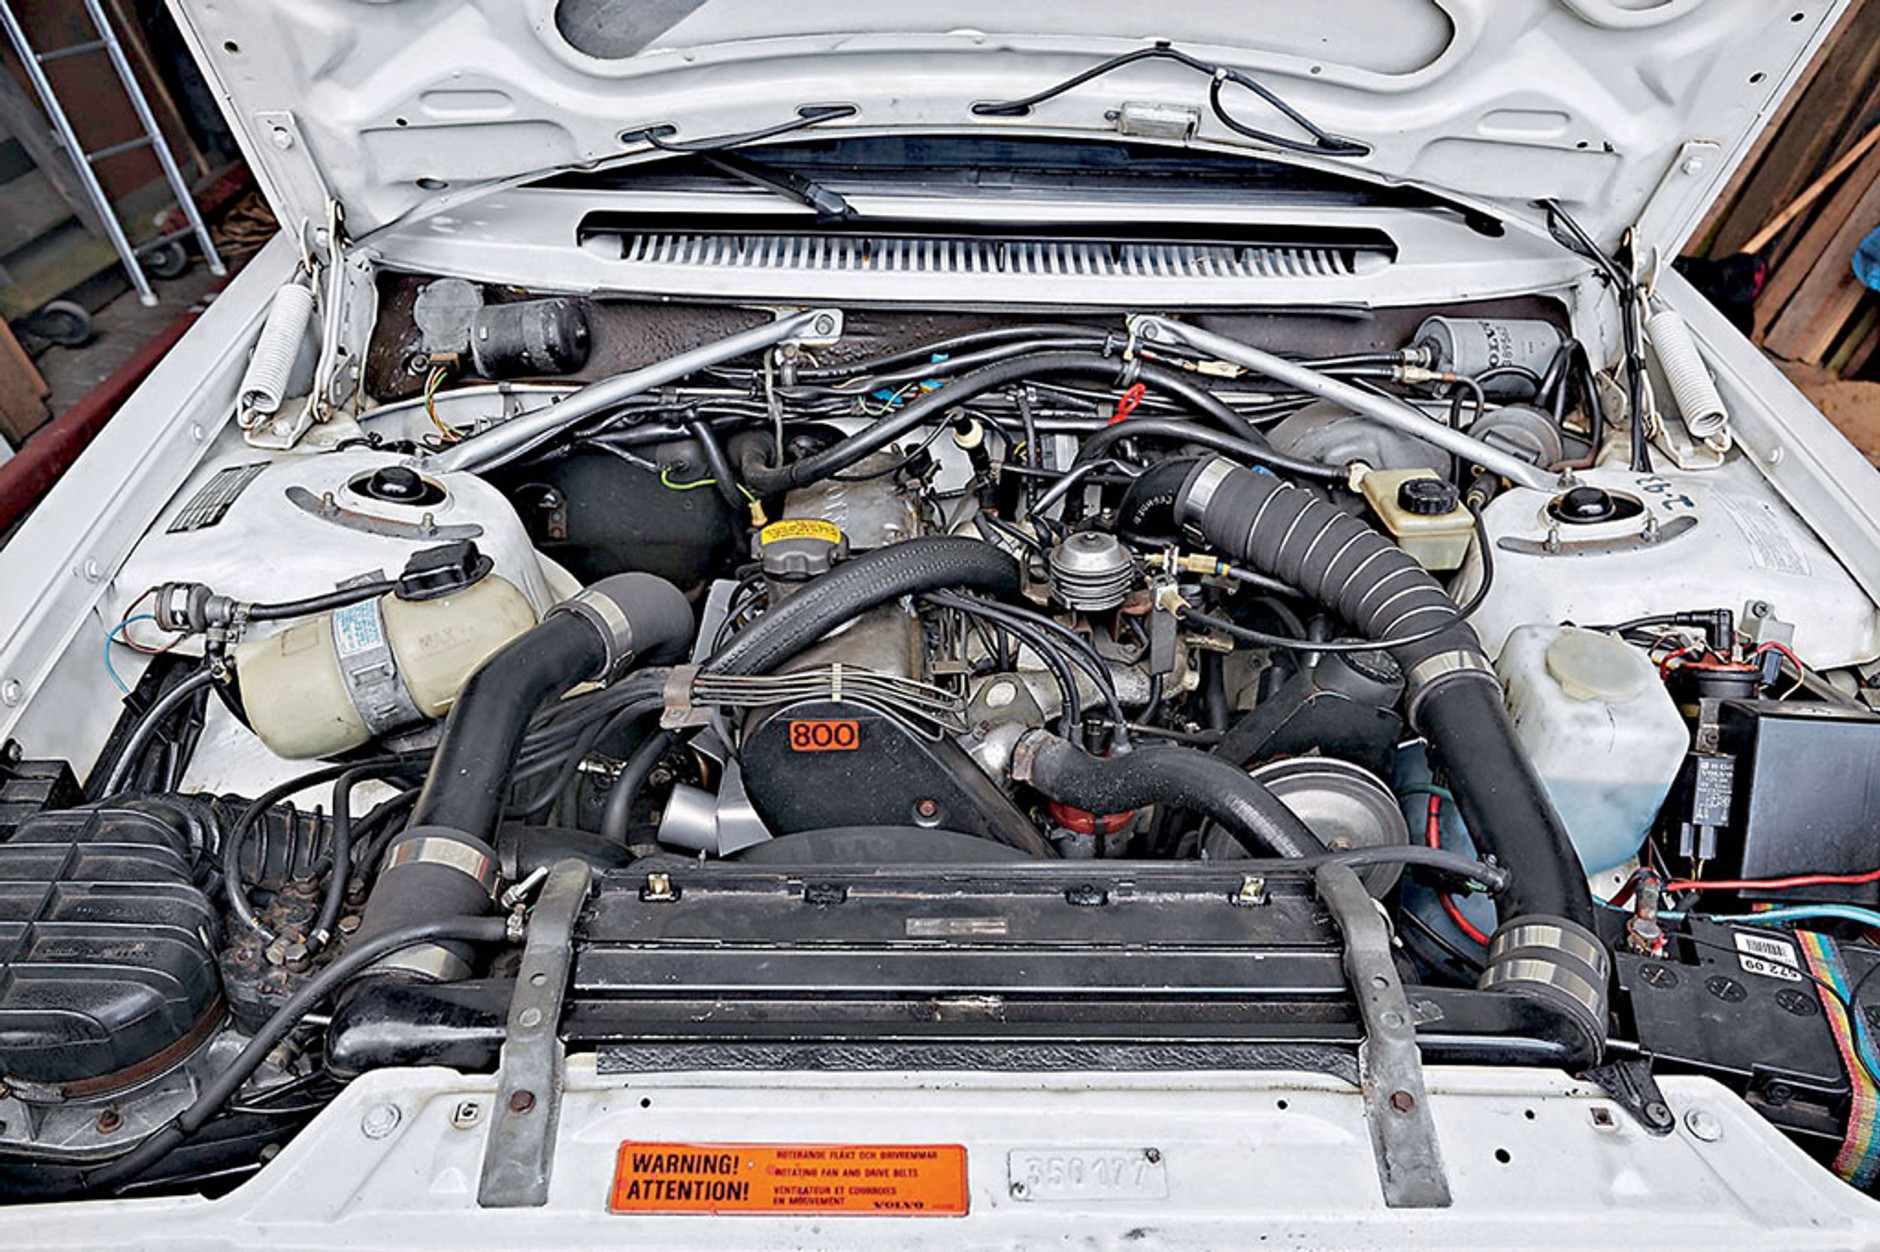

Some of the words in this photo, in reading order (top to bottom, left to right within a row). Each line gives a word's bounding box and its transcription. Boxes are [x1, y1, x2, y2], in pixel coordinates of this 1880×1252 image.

[794, 723, 855, 747] 800
[632, 1153, 740, 1175] WARNING!
[774, 1168, 818, 1176] ROTATING
[821, 1167, 838, 1176] FAN
[843, 1168, 861, 1177] AND
[864, 1168, 889, 1178] DRIVE
[893, 1168, 918, 1178] BELTS
[627, 1180, 749, 1201] ATTENTION!
[834, 1186, 844, 1195] ET
[773, 1196, 785, 1205] EN
[873, 1201, 925, 1209] VOLVO
